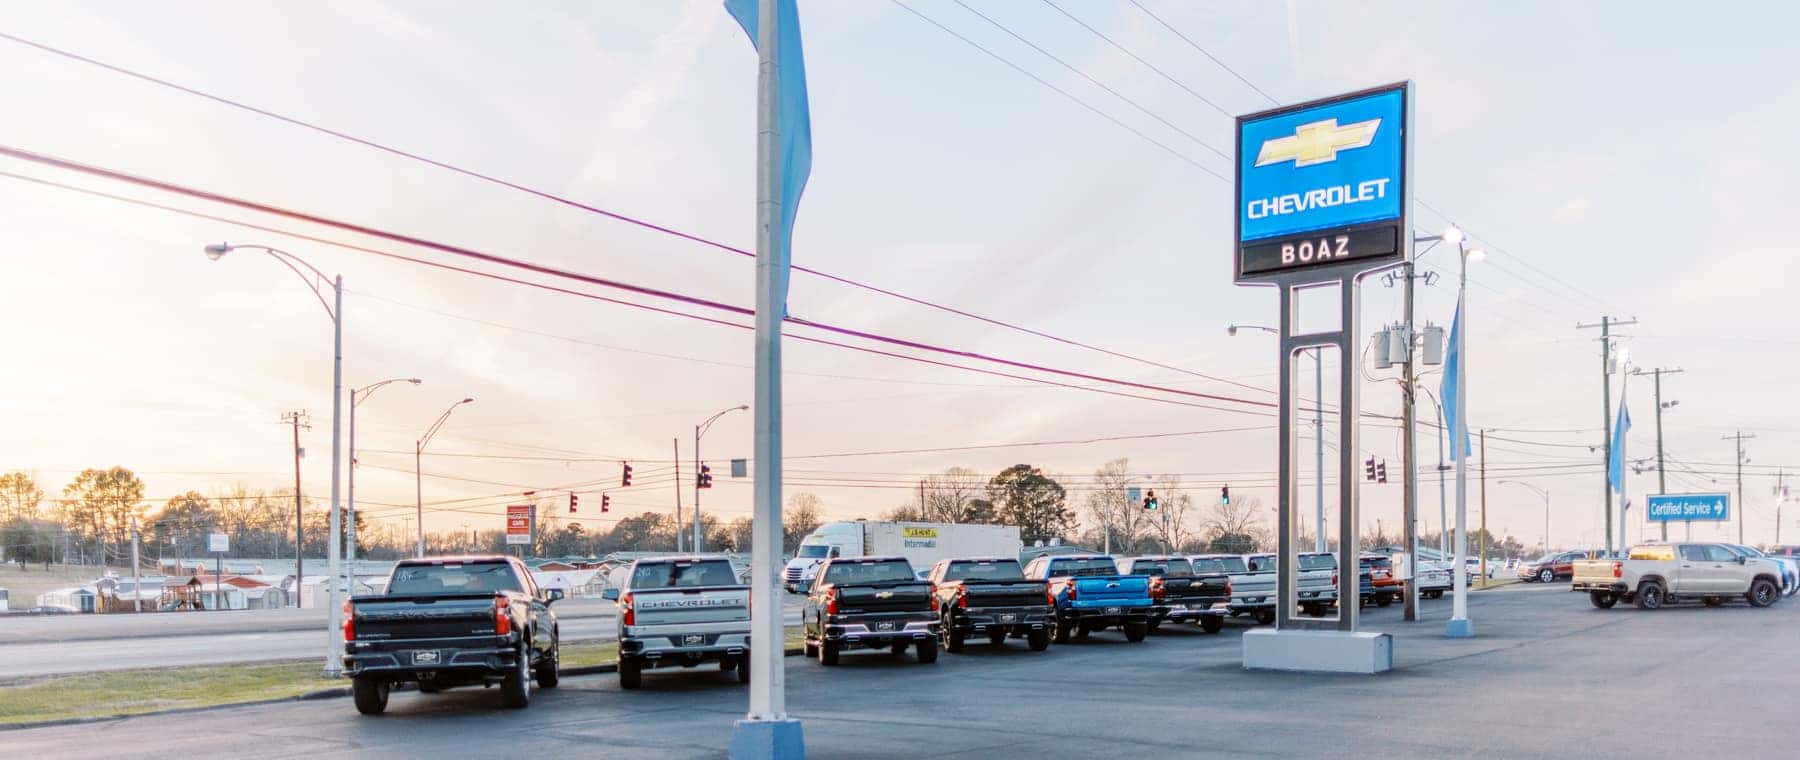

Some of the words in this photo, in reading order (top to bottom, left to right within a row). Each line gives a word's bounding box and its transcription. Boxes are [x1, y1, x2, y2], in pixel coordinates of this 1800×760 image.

[1247, 178, 1391, 220] CHEVROLET
[1281, 235, 1350, 264] BOAZ
[1650, 501, 1682, 515] Certified
[1683, 501, 1712, 514] Service
[641, 598, 743, 609] CHEVROLET
